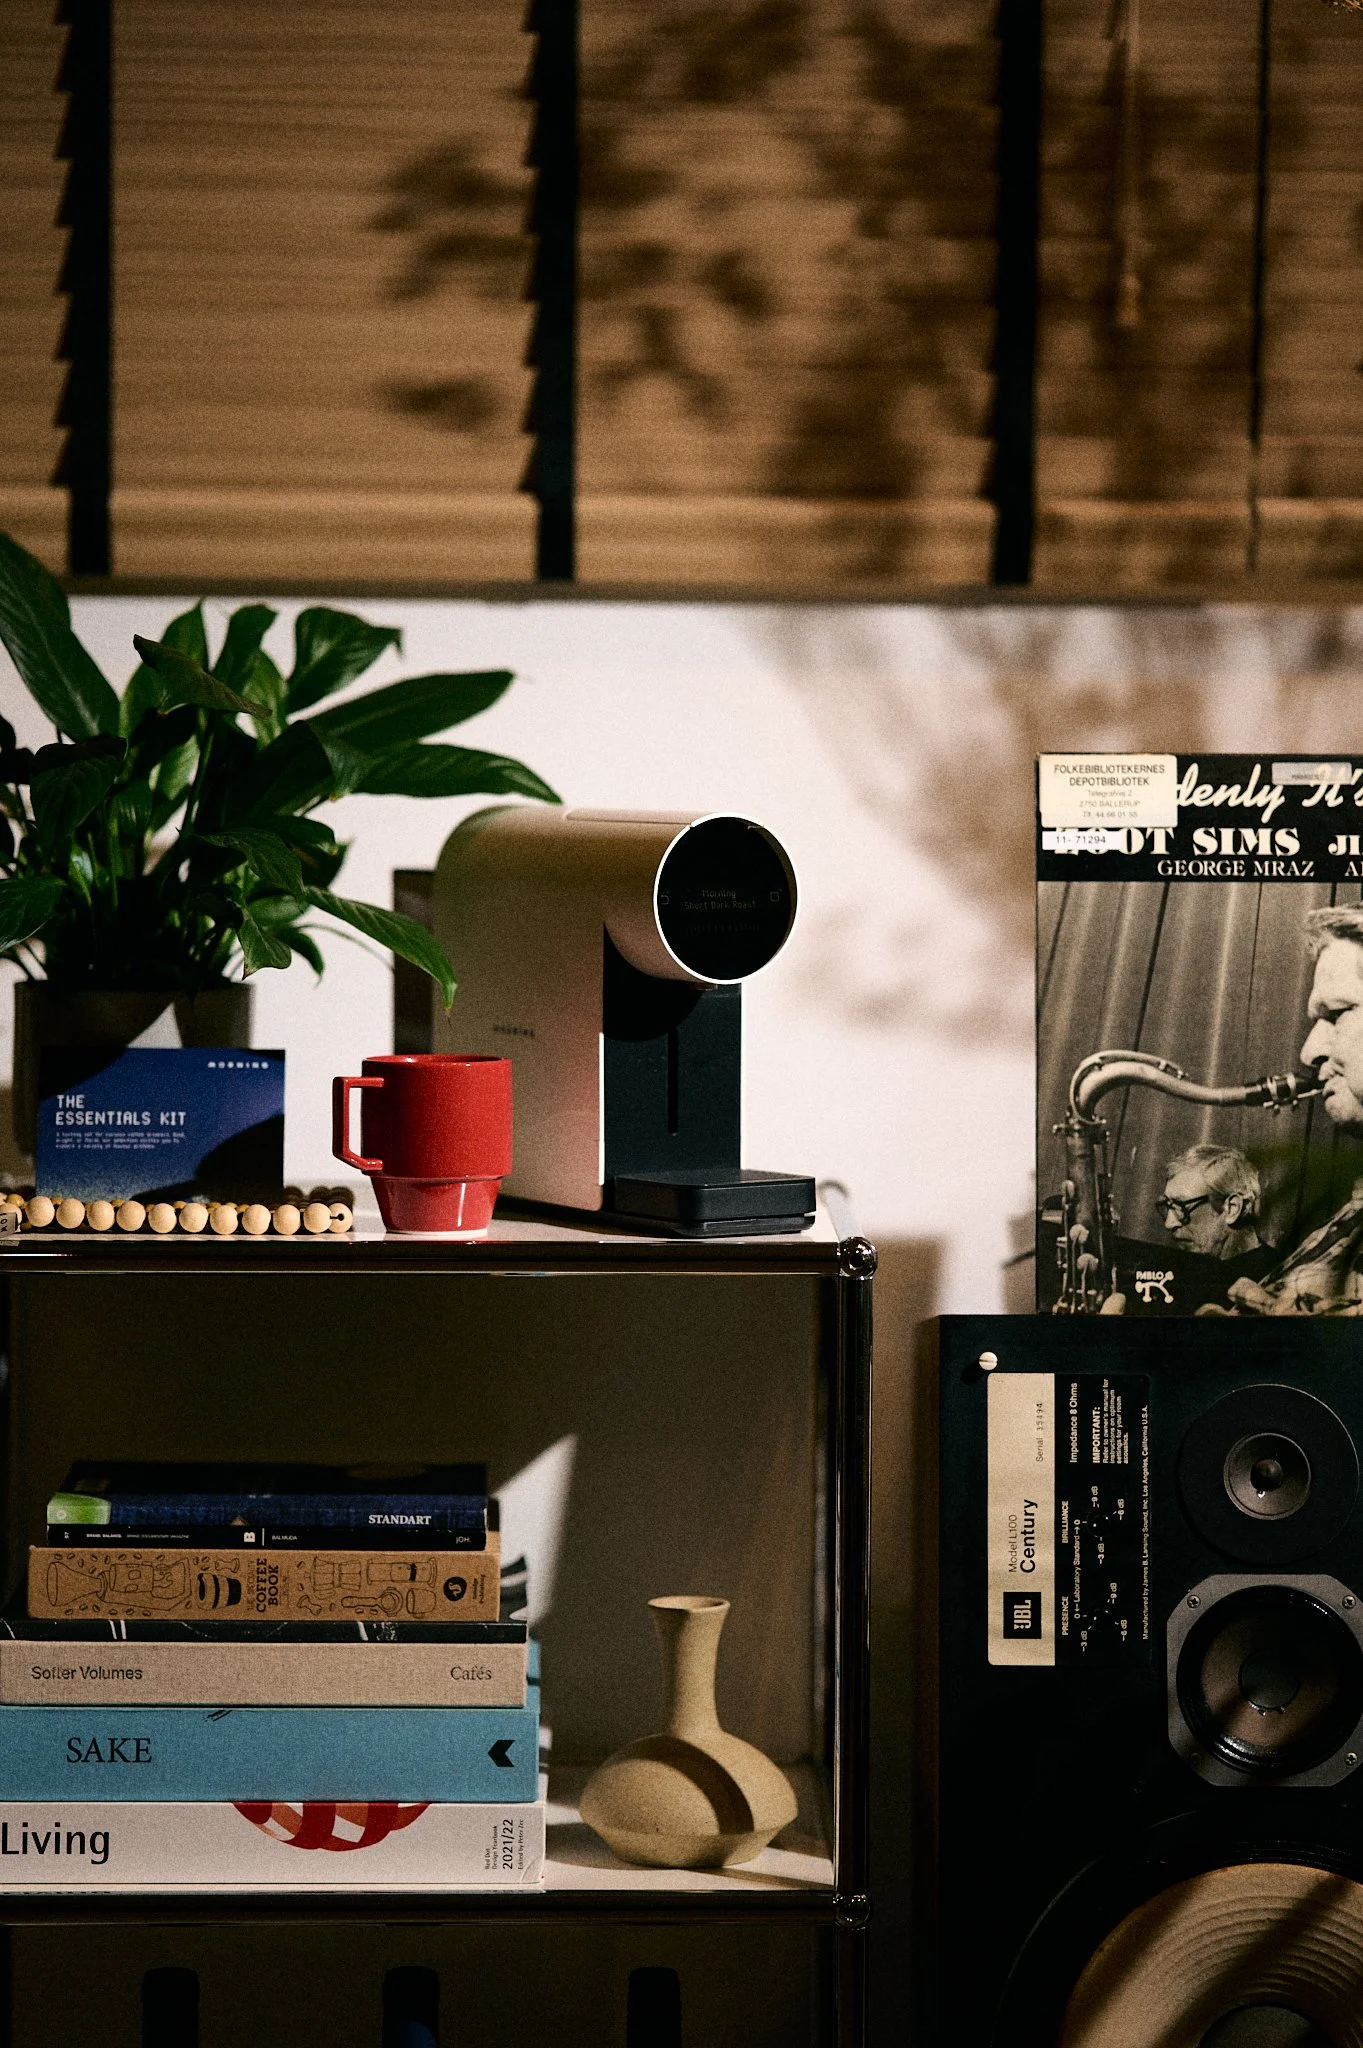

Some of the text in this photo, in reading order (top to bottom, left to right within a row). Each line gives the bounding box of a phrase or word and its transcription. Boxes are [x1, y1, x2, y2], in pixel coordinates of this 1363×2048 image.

[1054, 764, 1165, 774] FOLKEBIBLIOTEKERNES
[1069, 776, 1150, 786] DEPOTBIBLIOTEK
[1075, 835, 1106, 844] 71294
[1192, 827, 1300, 857] SIMS
[1328, 834, 1363, 856] JI
[1157, 860, 1363, 877] GEORGE MRAZ A
[57, 1094, 85, 1109] THE
[55, 1111, 187, 1126] ESSENTIALS KIT
[1135, 1271, 1164, 1281] PABLO
[1069, 1383, 1078, 1408] Ohms
[1110, 1417, 1115, 1426] on
[1069, 1416, 1078, 1463] Impedance
[1092, 1406, 1101, 1463] IMPORTANT:
[1091, 1486, 1098, 1495] dB
[1118, 1499, 1124, 1508] dB
[368, 1514, 431, 1525] STANDART
[1009, 1514, 1017, 1572] Model L100
[1019, 1499, 1038, 1573] Century
[1098, 1543, 1104, 1553] dB
[256, 1558, 266, 1613] COFFEE
[268, 1565, 278, 1606] BOOK
[1110, 1583, 1117, 1592] dB
[1013, 1599, 1031, 1630] JBL
[1121, 1620, 1127, 1629] dB
[1081, 1631, 1088, 1640] dB
[79, 1665, 143, 1680] Volumes
[450, 1665, 492, 1681] Cafés
[66, 1737, 152, 1763] SAKE
[1, 1822, 110, 1865] Living
[501, 1819, 515, 1870] 2021/22
